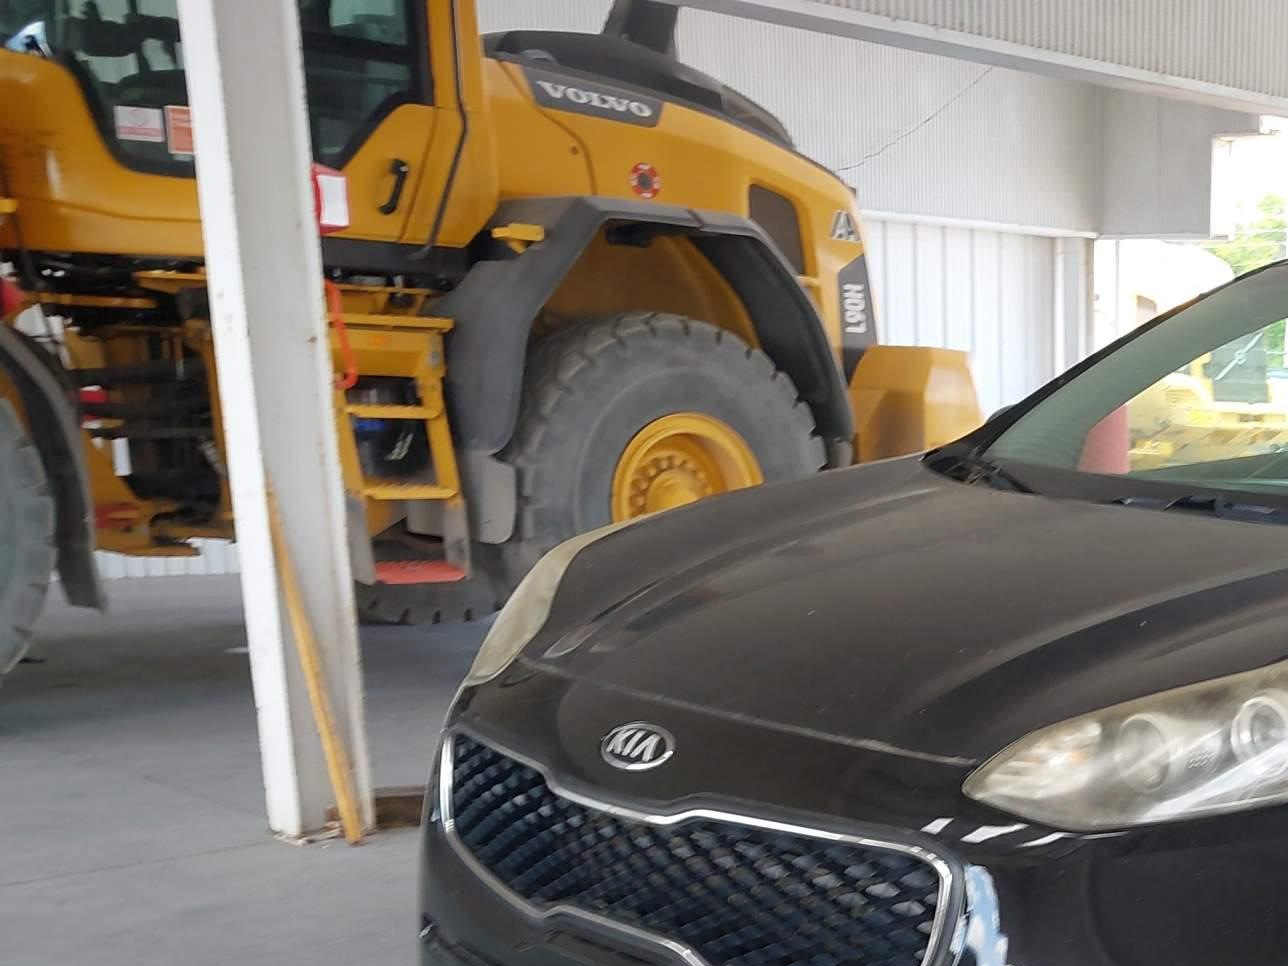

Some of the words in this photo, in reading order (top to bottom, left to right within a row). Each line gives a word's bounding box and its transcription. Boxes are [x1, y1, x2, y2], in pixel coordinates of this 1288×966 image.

[535, 80, 653, 117] VOLVO
[842, 283, 867, 333] L90H
[605, 727, 663, 762] KIA
